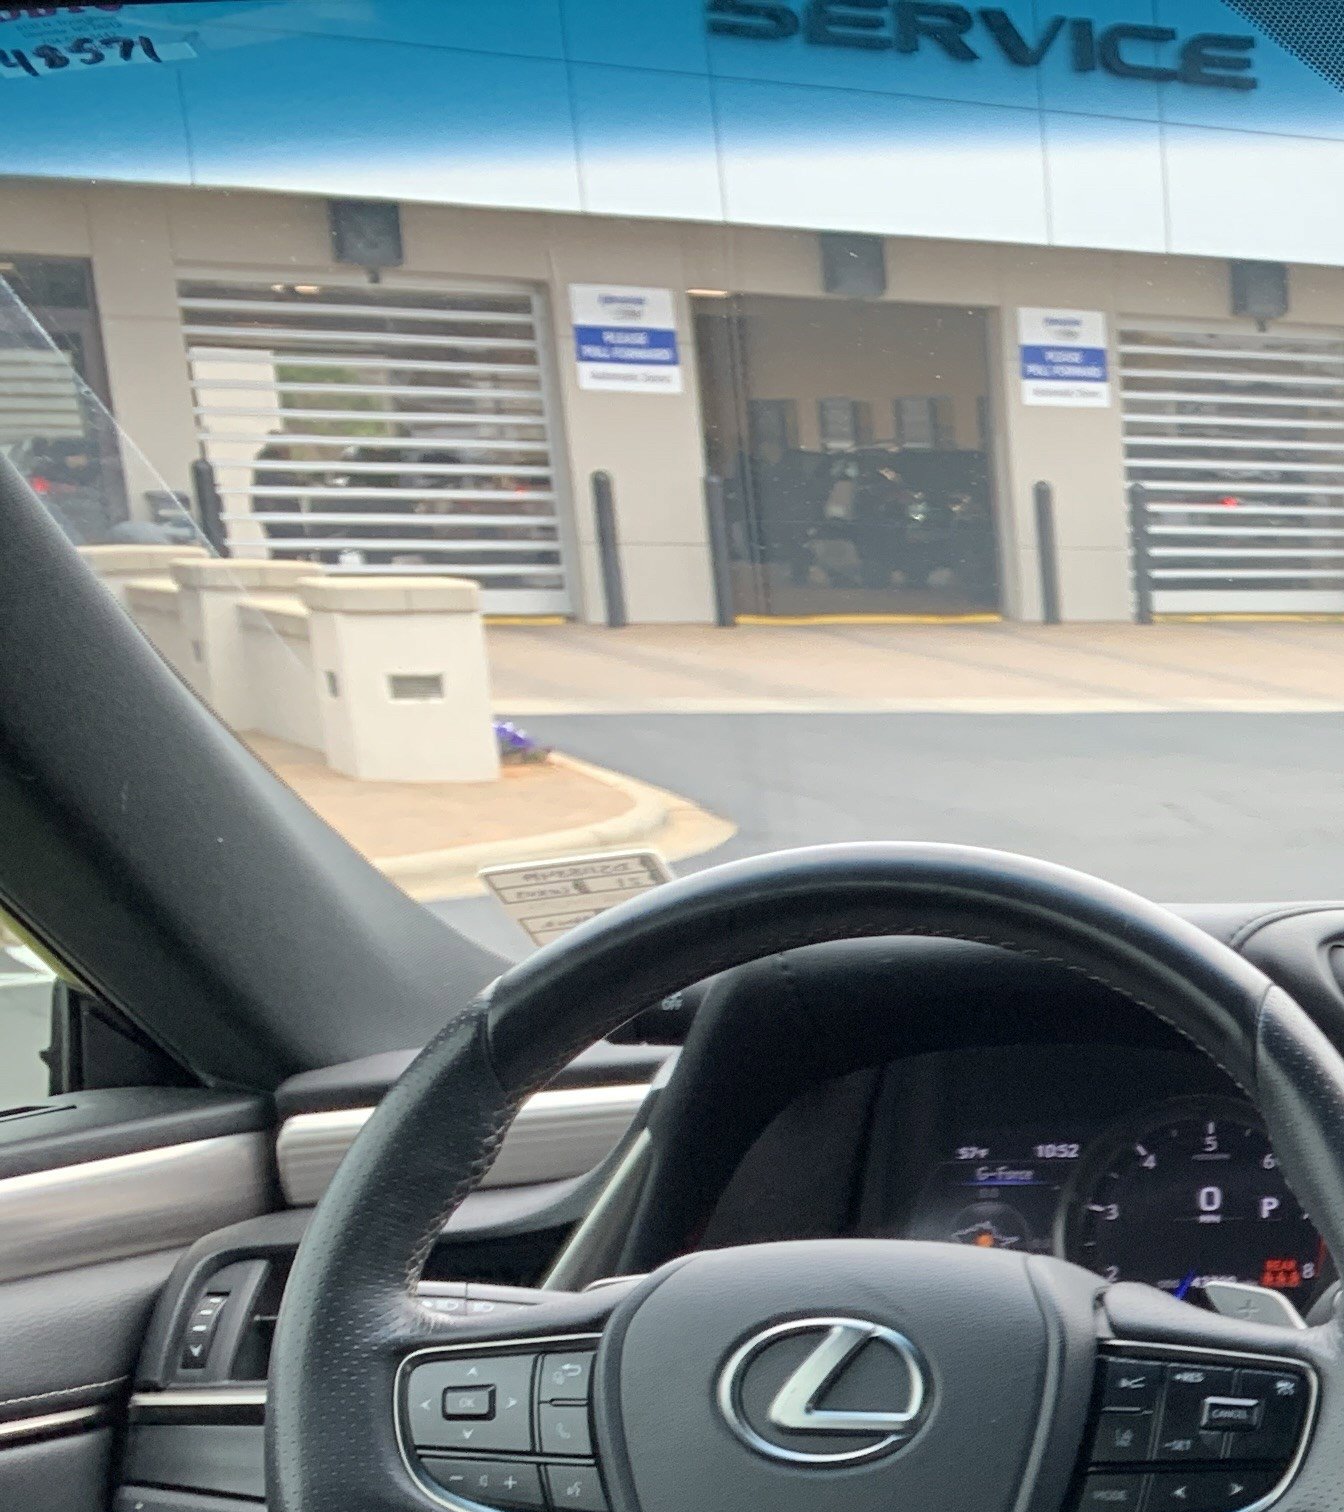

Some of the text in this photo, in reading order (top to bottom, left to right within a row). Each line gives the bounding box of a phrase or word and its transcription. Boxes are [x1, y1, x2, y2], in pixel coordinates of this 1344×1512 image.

[707, 0, 1258, 90] SERVICE
[1204, 1136, 1218, 1152] 5
[1141, 1154, 1157, 1170] 4
[1262, 1154, 1276, 1169] 6
[1199, 1186, 1279, 1218] 0 P
[1104, 1203, 1119, 1221] 3
[1302, 1262, 1315, 1279] 8
